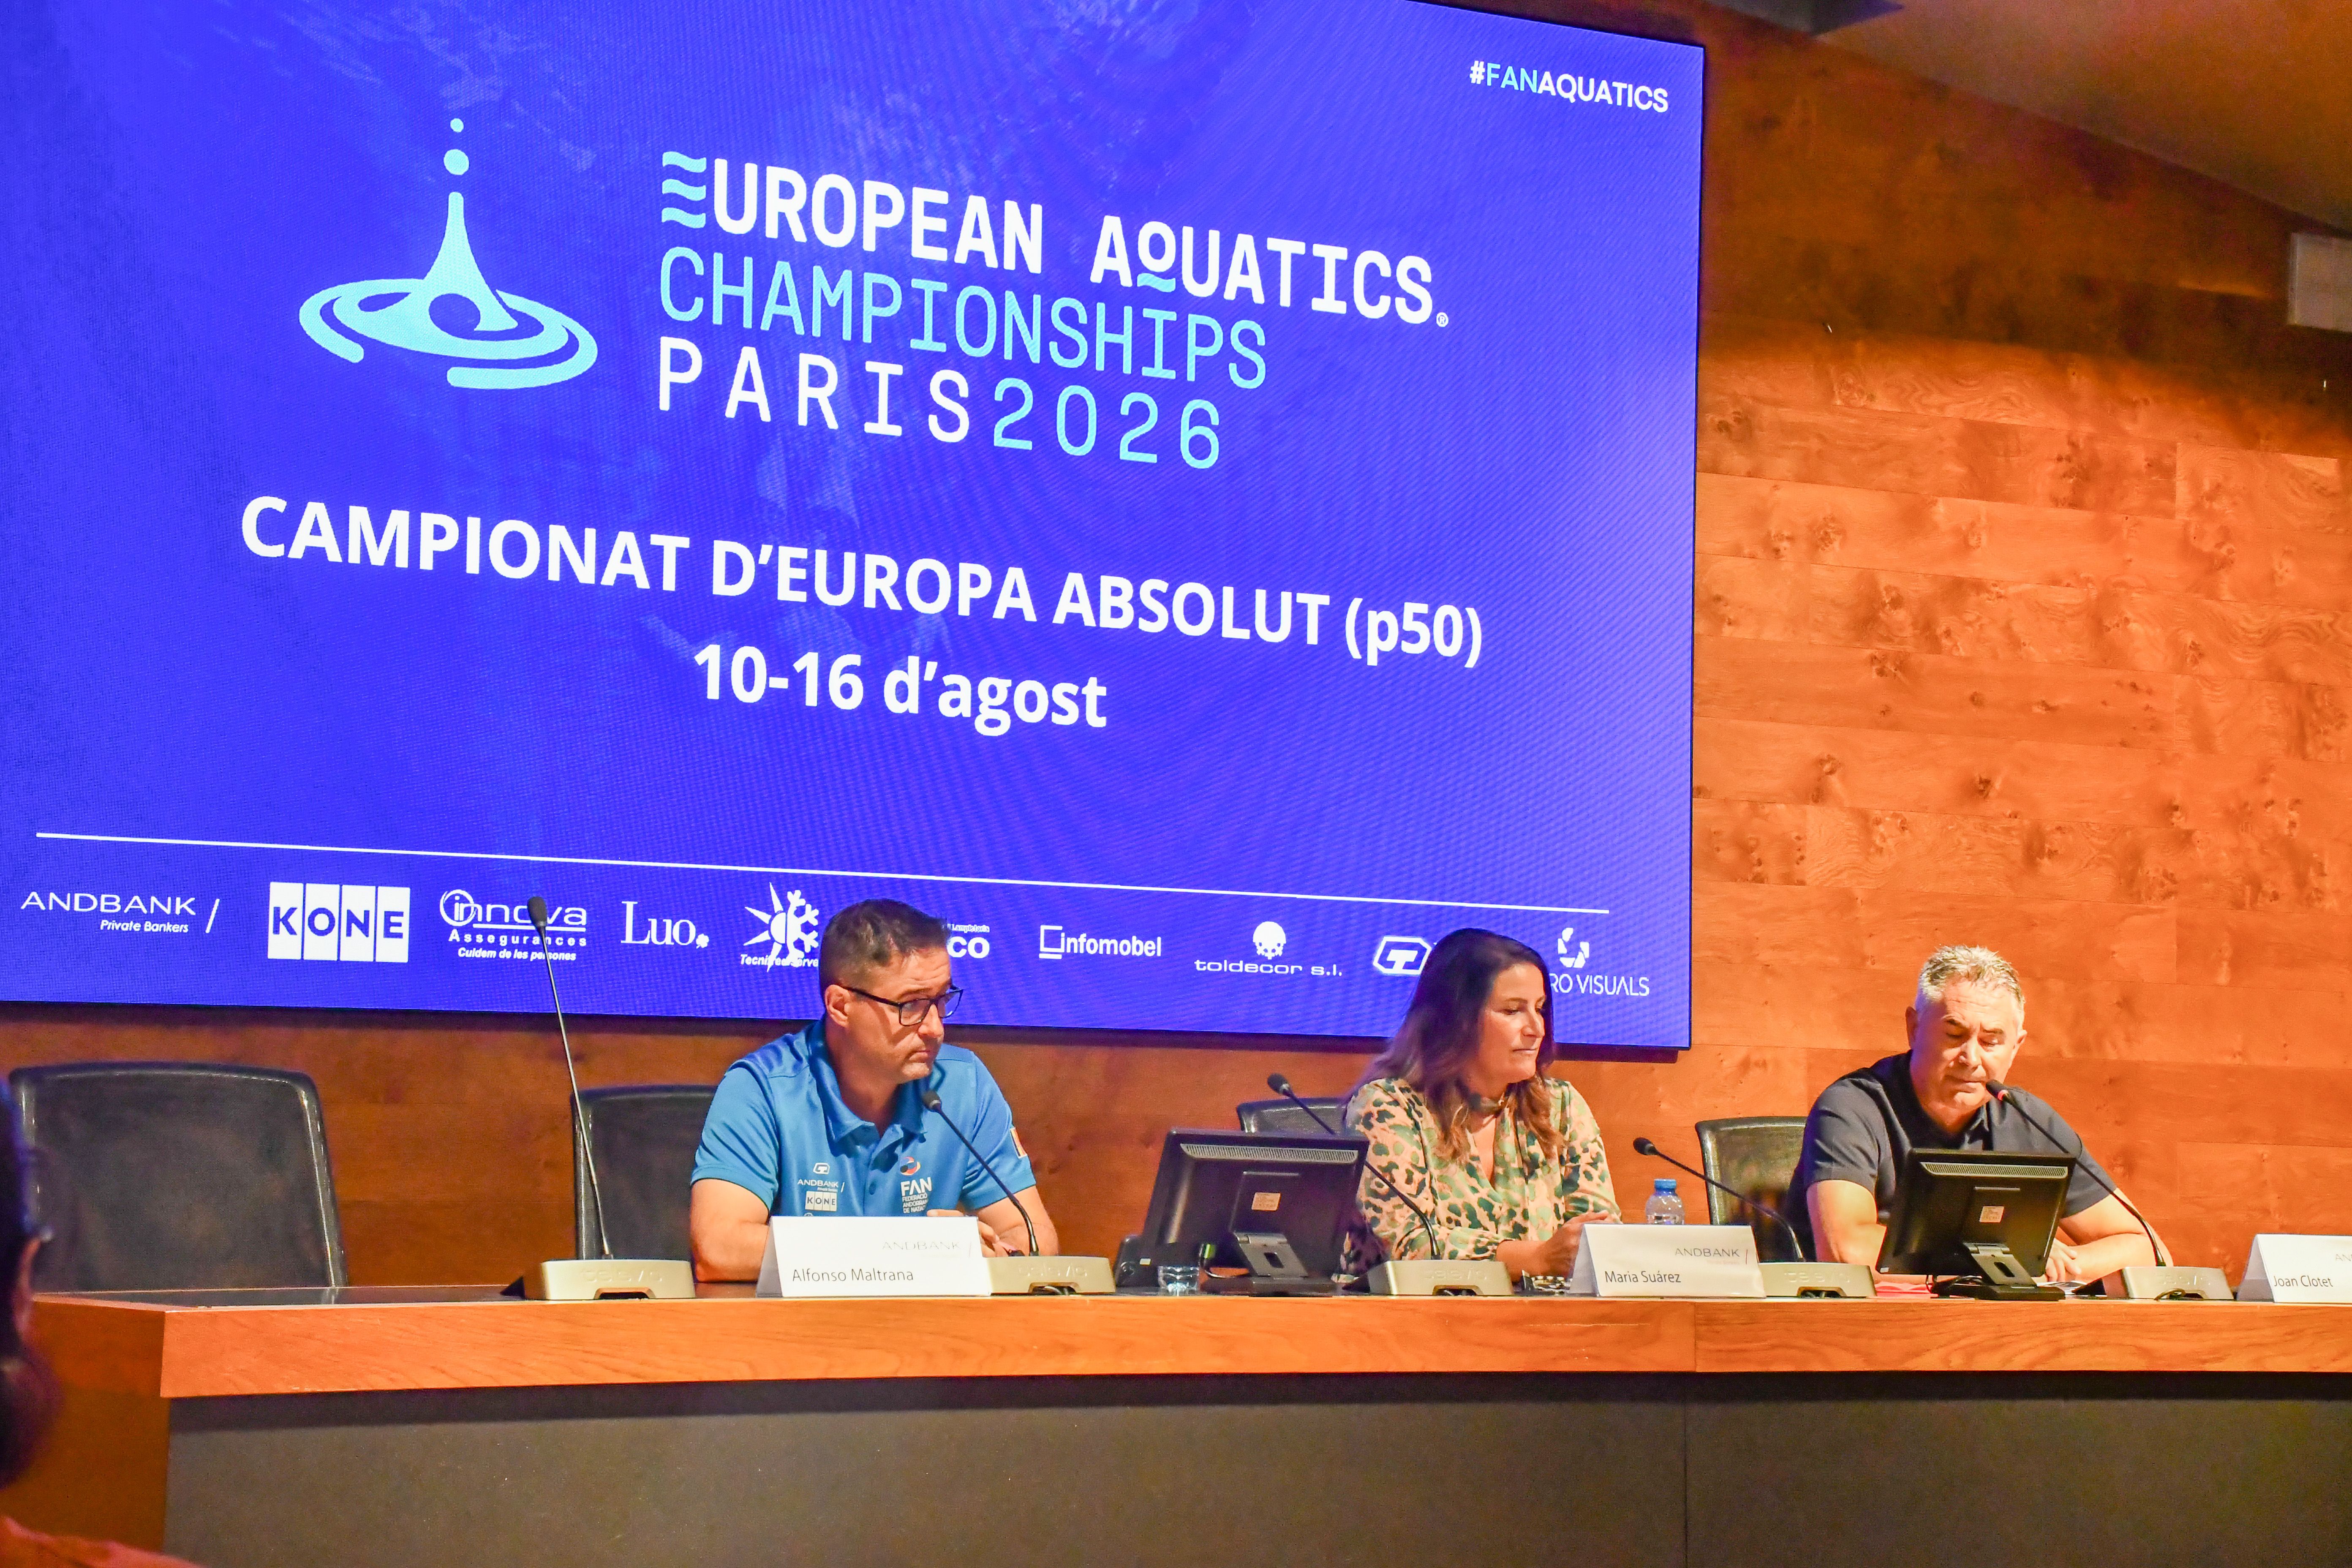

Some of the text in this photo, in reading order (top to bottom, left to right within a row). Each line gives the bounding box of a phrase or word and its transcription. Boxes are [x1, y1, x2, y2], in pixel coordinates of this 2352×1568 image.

[1470, 60, 1668, 112] #FANAQUATICS
[662, 151, 1043, 274] EUROPEAN
[660, 246, 1266, 389] CHAMPIONSHIPS
[659, 336, 1220, 469] PARIS 2026
[242, 496, 1482, 668] CAMPIONAT D'EUROPA ABSOLUT (p50)
[694, 644, 1106, 736] 10-16 d'agost
[21, 891, 196, 915] ANDBANK
[101, 920, 189, 933] Private Bankers
[272, 905, 404, 939] KONE
[449, 929, 586, 946] Assegurances
[1060, 932, 1161, 957] infomobel
[458, 947, 496, 958] Cuidem
[499, 949, 512, 958] de
[514, 949, 528, 959] les
[1194, 959, 1342, 976] toldecor s.l.
[1549, 973, 1650, 996] RO VISUALS
[798, 1179, 838, 1188] ANDBANK
[901, 1177, 932, 1196] FAN
[807, 1197, 836, 1205] KONE
[903, 1199, 928, 1208] ANDORRAN
[882, 1241, 960, 1251] ANDBANK
[1675, 1248, 1740, 1258] ANDBANK
[792, 1268, 913, 1282] Alfonso Maltrana
[1605, 1270, 1681, 1283] Maria Suárez
[2273, 1275, 2333, 1287] Joan Clotet
